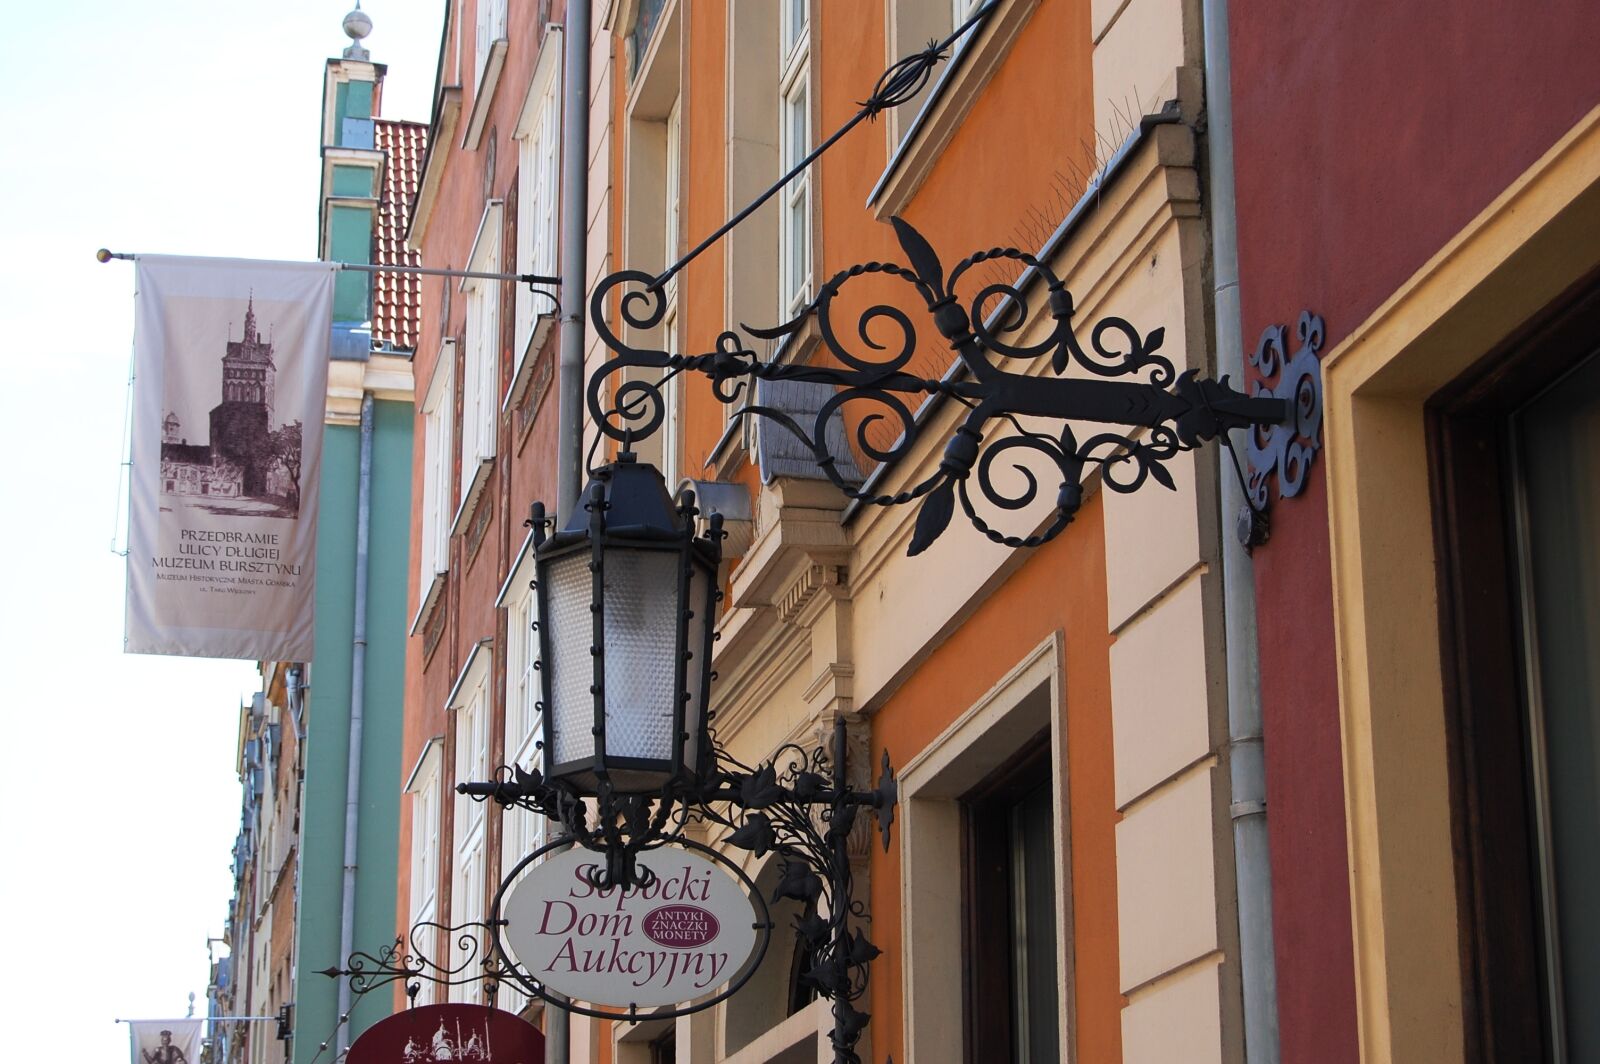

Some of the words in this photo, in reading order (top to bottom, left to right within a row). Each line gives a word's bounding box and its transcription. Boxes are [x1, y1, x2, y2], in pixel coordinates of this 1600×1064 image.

[181, 529, 279, 545] PRZEDBRAMIE
[179, 544, 222, 556] ULICY
[225, 546, 280, 561] DŁUGIEJ
[152, 557, 215, 570] MUZEUM
[219, 560, 301, 576] BURSZTYNU
[568, 863, 711, 911] Sopocki
[535, 900, 633, 937] Dom
[655, 911, 704, 921] ANTYKI
[651, 920, 709, 931] ZNACZKI
[653, 930, 708, 940] MONETY
[542, 937, 728, 989] Aukcyjny
